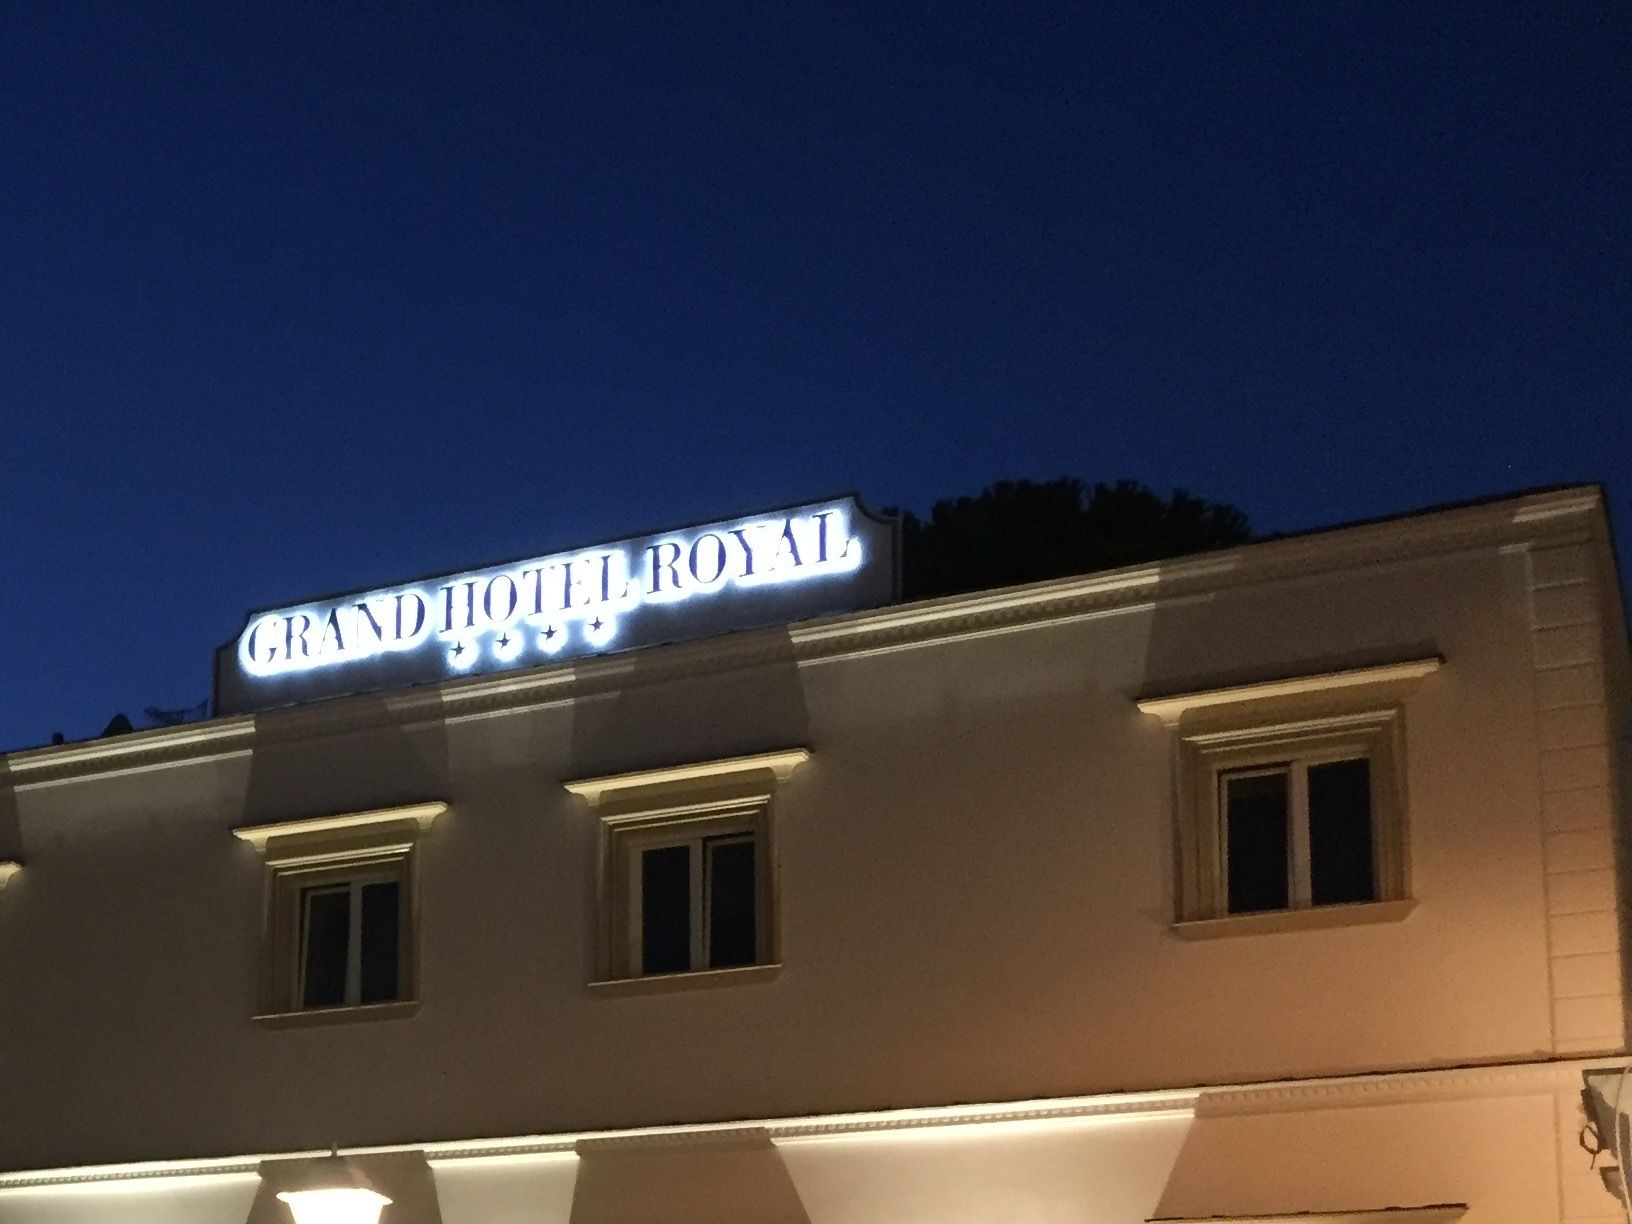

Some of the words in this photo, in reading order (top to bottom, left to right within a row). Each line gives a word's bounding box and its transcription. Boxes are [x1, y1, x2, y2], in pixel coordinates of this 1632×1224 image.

[247, 593, 427, 663] GRAND
[439, 554, 630, 634] HOTEL
[646, 512, 851, 595] ROYAL
